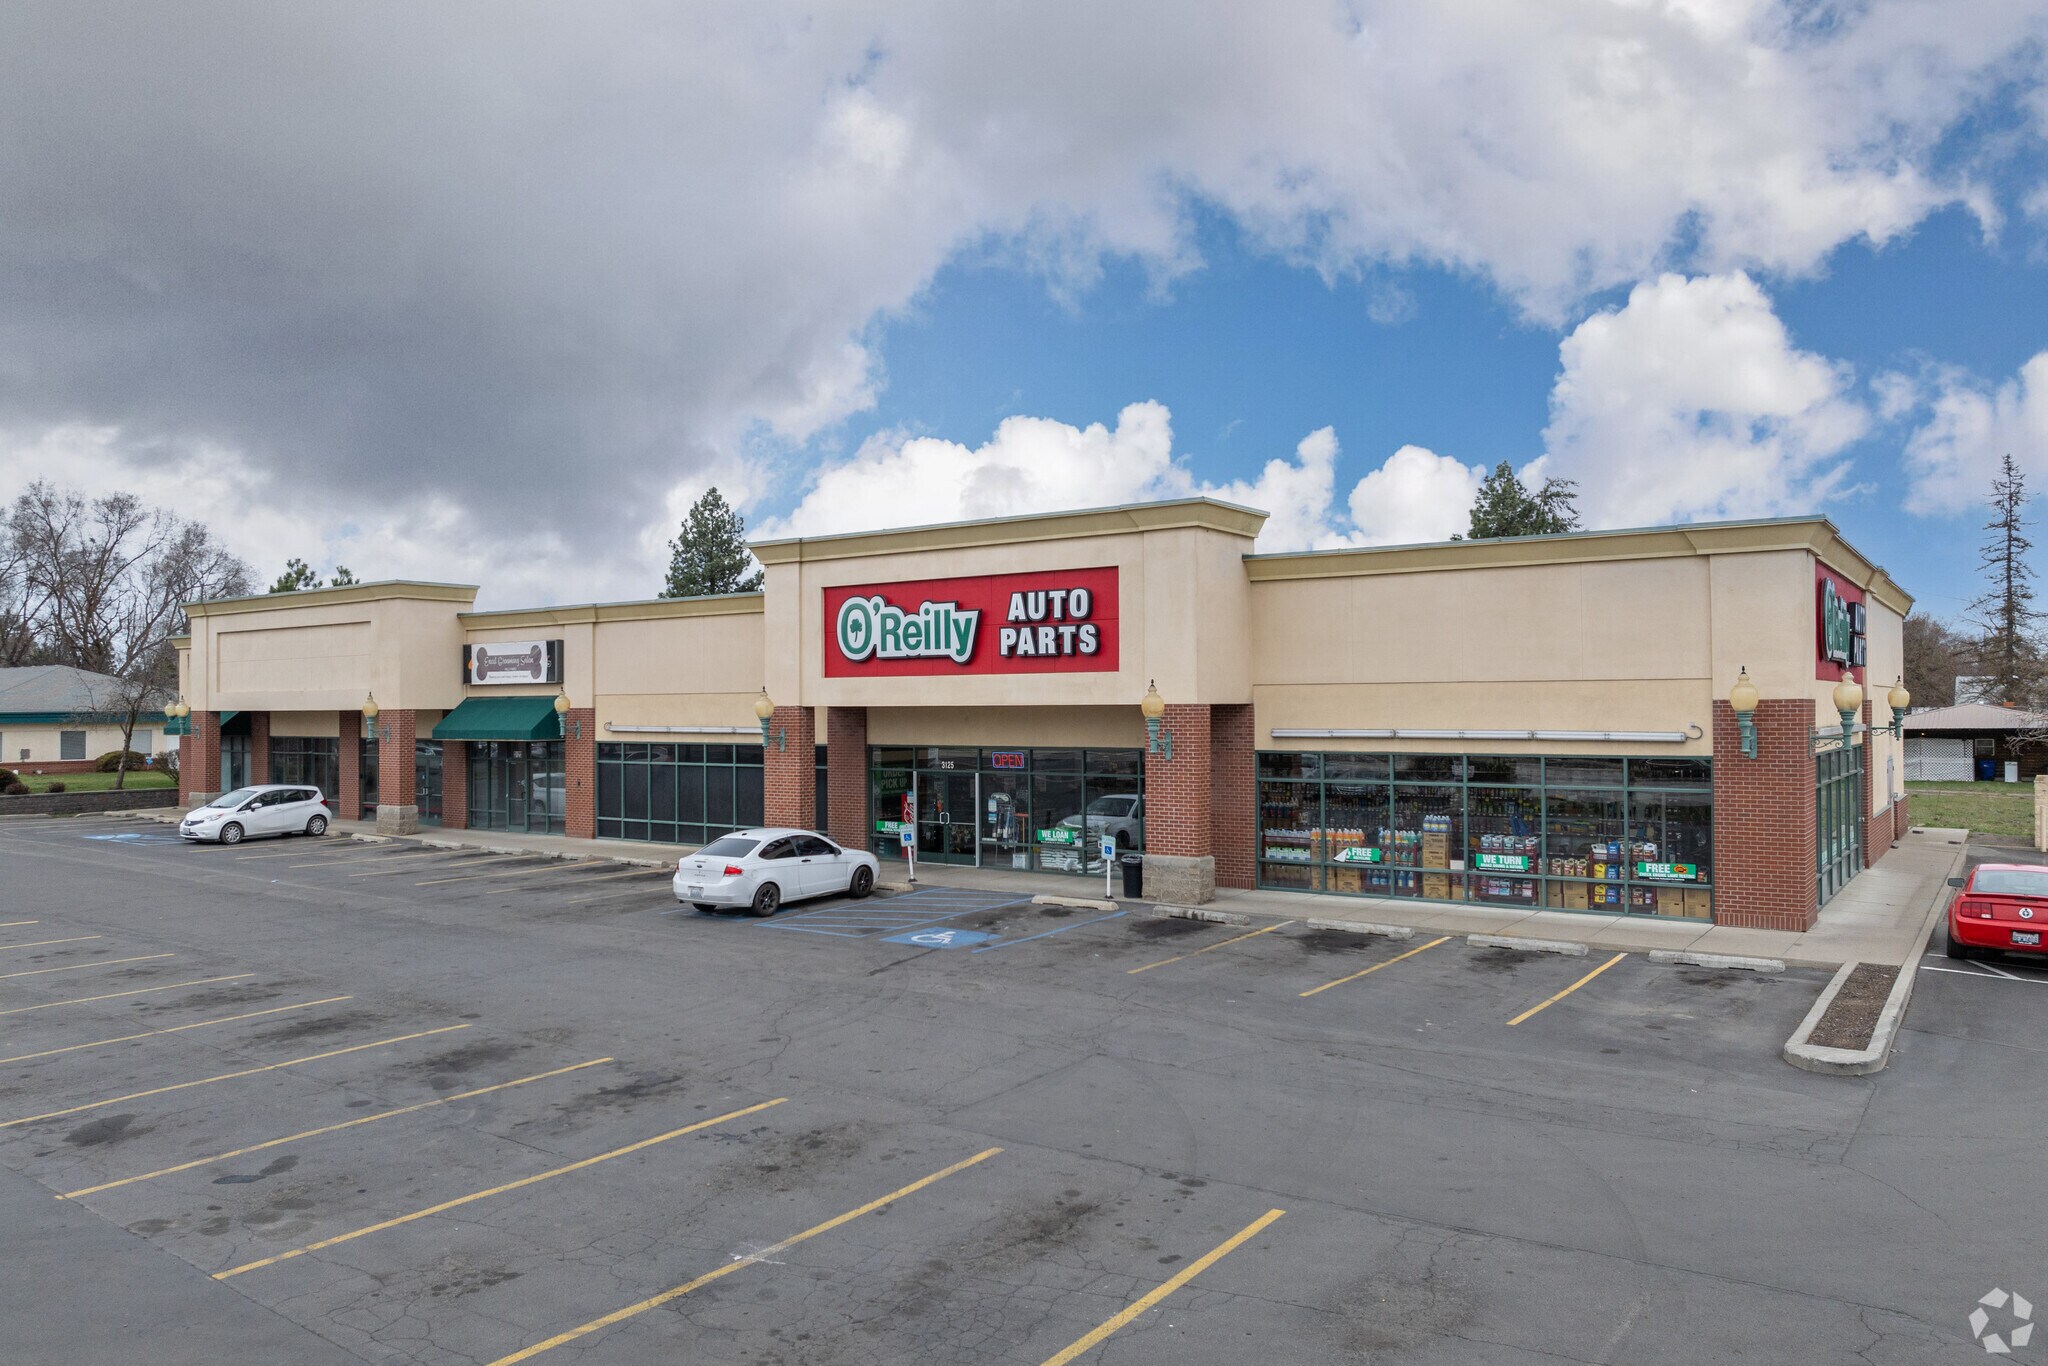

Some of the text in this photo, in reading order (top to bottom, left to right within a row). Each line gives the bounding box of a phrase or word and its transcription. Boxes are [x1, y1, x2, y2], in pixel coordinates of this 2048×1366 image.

[1007, 588, 1092, 622] AUTO
[840, 601, 974, 657] O'Reilly
[1000, 623, 1098, 657] PARTS
[941, 761, 955, 769] 3125
[993, 753, 1023, 767] OPEN
[881, 778, 898, 789] PICK
[884, 821, 898, 829] FREE
[1041, 830, 1069, 839] WE LOAN
[1352, 847, 1372, 857] FREE
[1482, 854, 1522, 865] WE TURN
[1645, 863, 1671, 873] FREE
